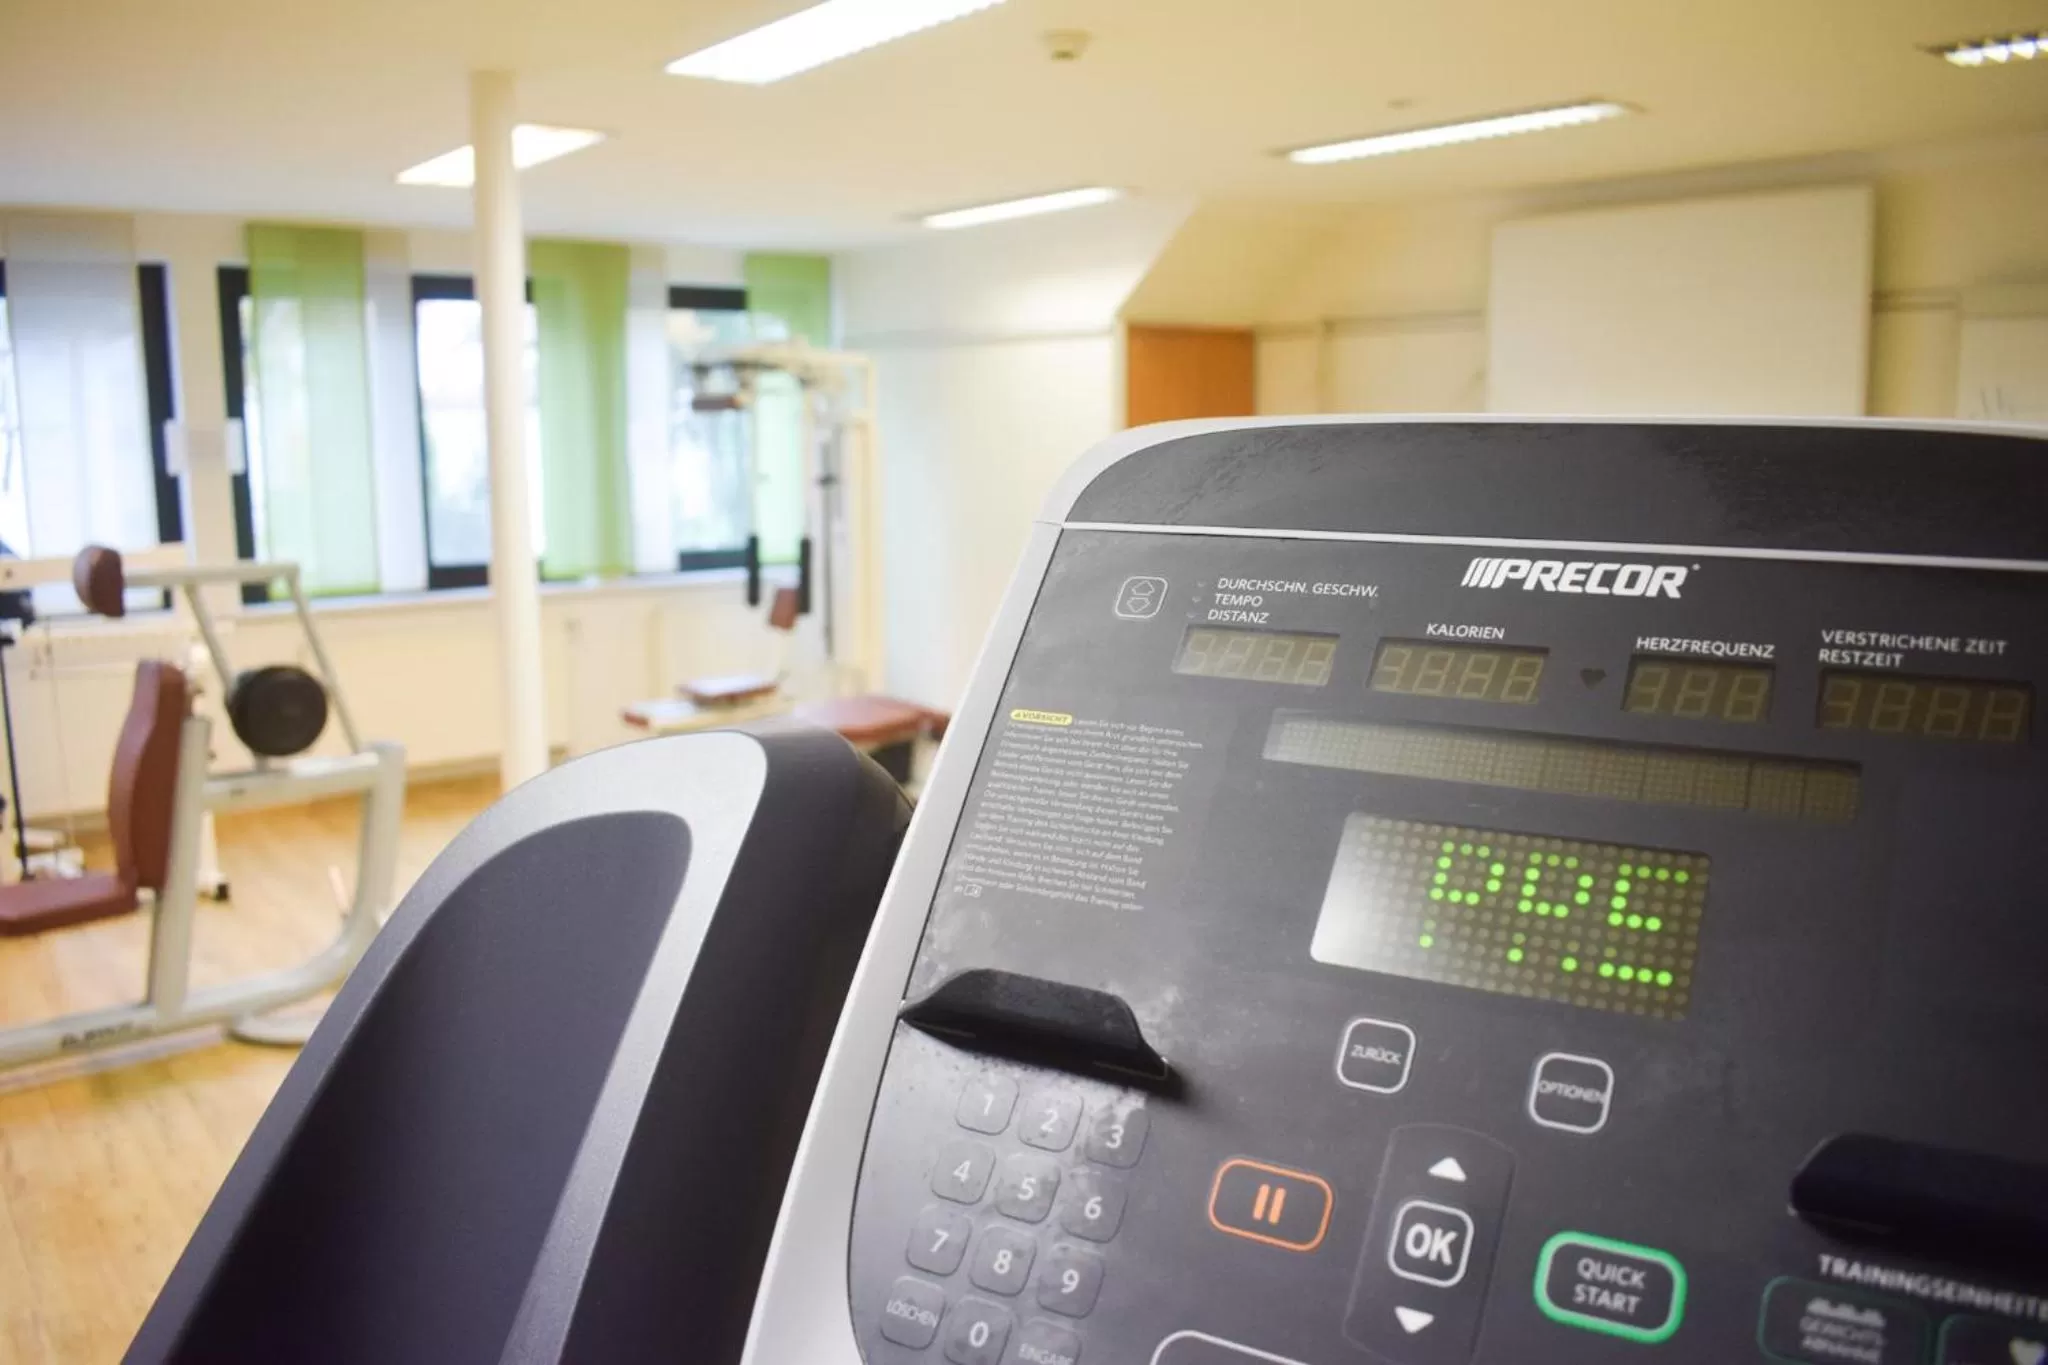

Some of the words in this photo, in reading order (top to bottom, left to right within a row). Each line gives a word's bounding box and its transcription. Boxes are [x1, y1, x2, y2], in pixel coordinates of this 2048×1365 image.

[1217, 577, 1308, 595] DURCHSCHN.
[1311, 582, 1380, 598] GESCHW.
[1461, 557, 1688, 599] PRECOR
[1214, 592, 1264, 608] TEMPO
[1207, 608, 1270, 624] DISTANZ
[1426, 623, 1505, 640] KALORIEN
[1821, 628, 1960, 654] VERSTRICHENE
[1964, 637, 2009, 656] ZEIT
[1636, 636, 1775, 659] HERZFREQUENZ
[1818, 648, 1904, 668] RESTZEIT
[983, 1093, 996, 1117] 1
[1040, 1109, 1059, 1134] 2
[1105, 1123, 1125, 1150] 3
[953, 1159, 971, 1184] 4
[1017, 1176, 1037, 1202] 5
[1083, 1195, 1102, 1220] 6
[929, 1227, 949, 1253] 7
[1404, 1222, 1459, 1266] OK
[993, 1249, 1013, 1275] 8
[1577, 1257, 1647, 1290] QUICK
[1060, 1268, 1080, 1294] 9
[1572, 1282, 1642, 1316] START
[969, 1320, 990, 1348] 0
